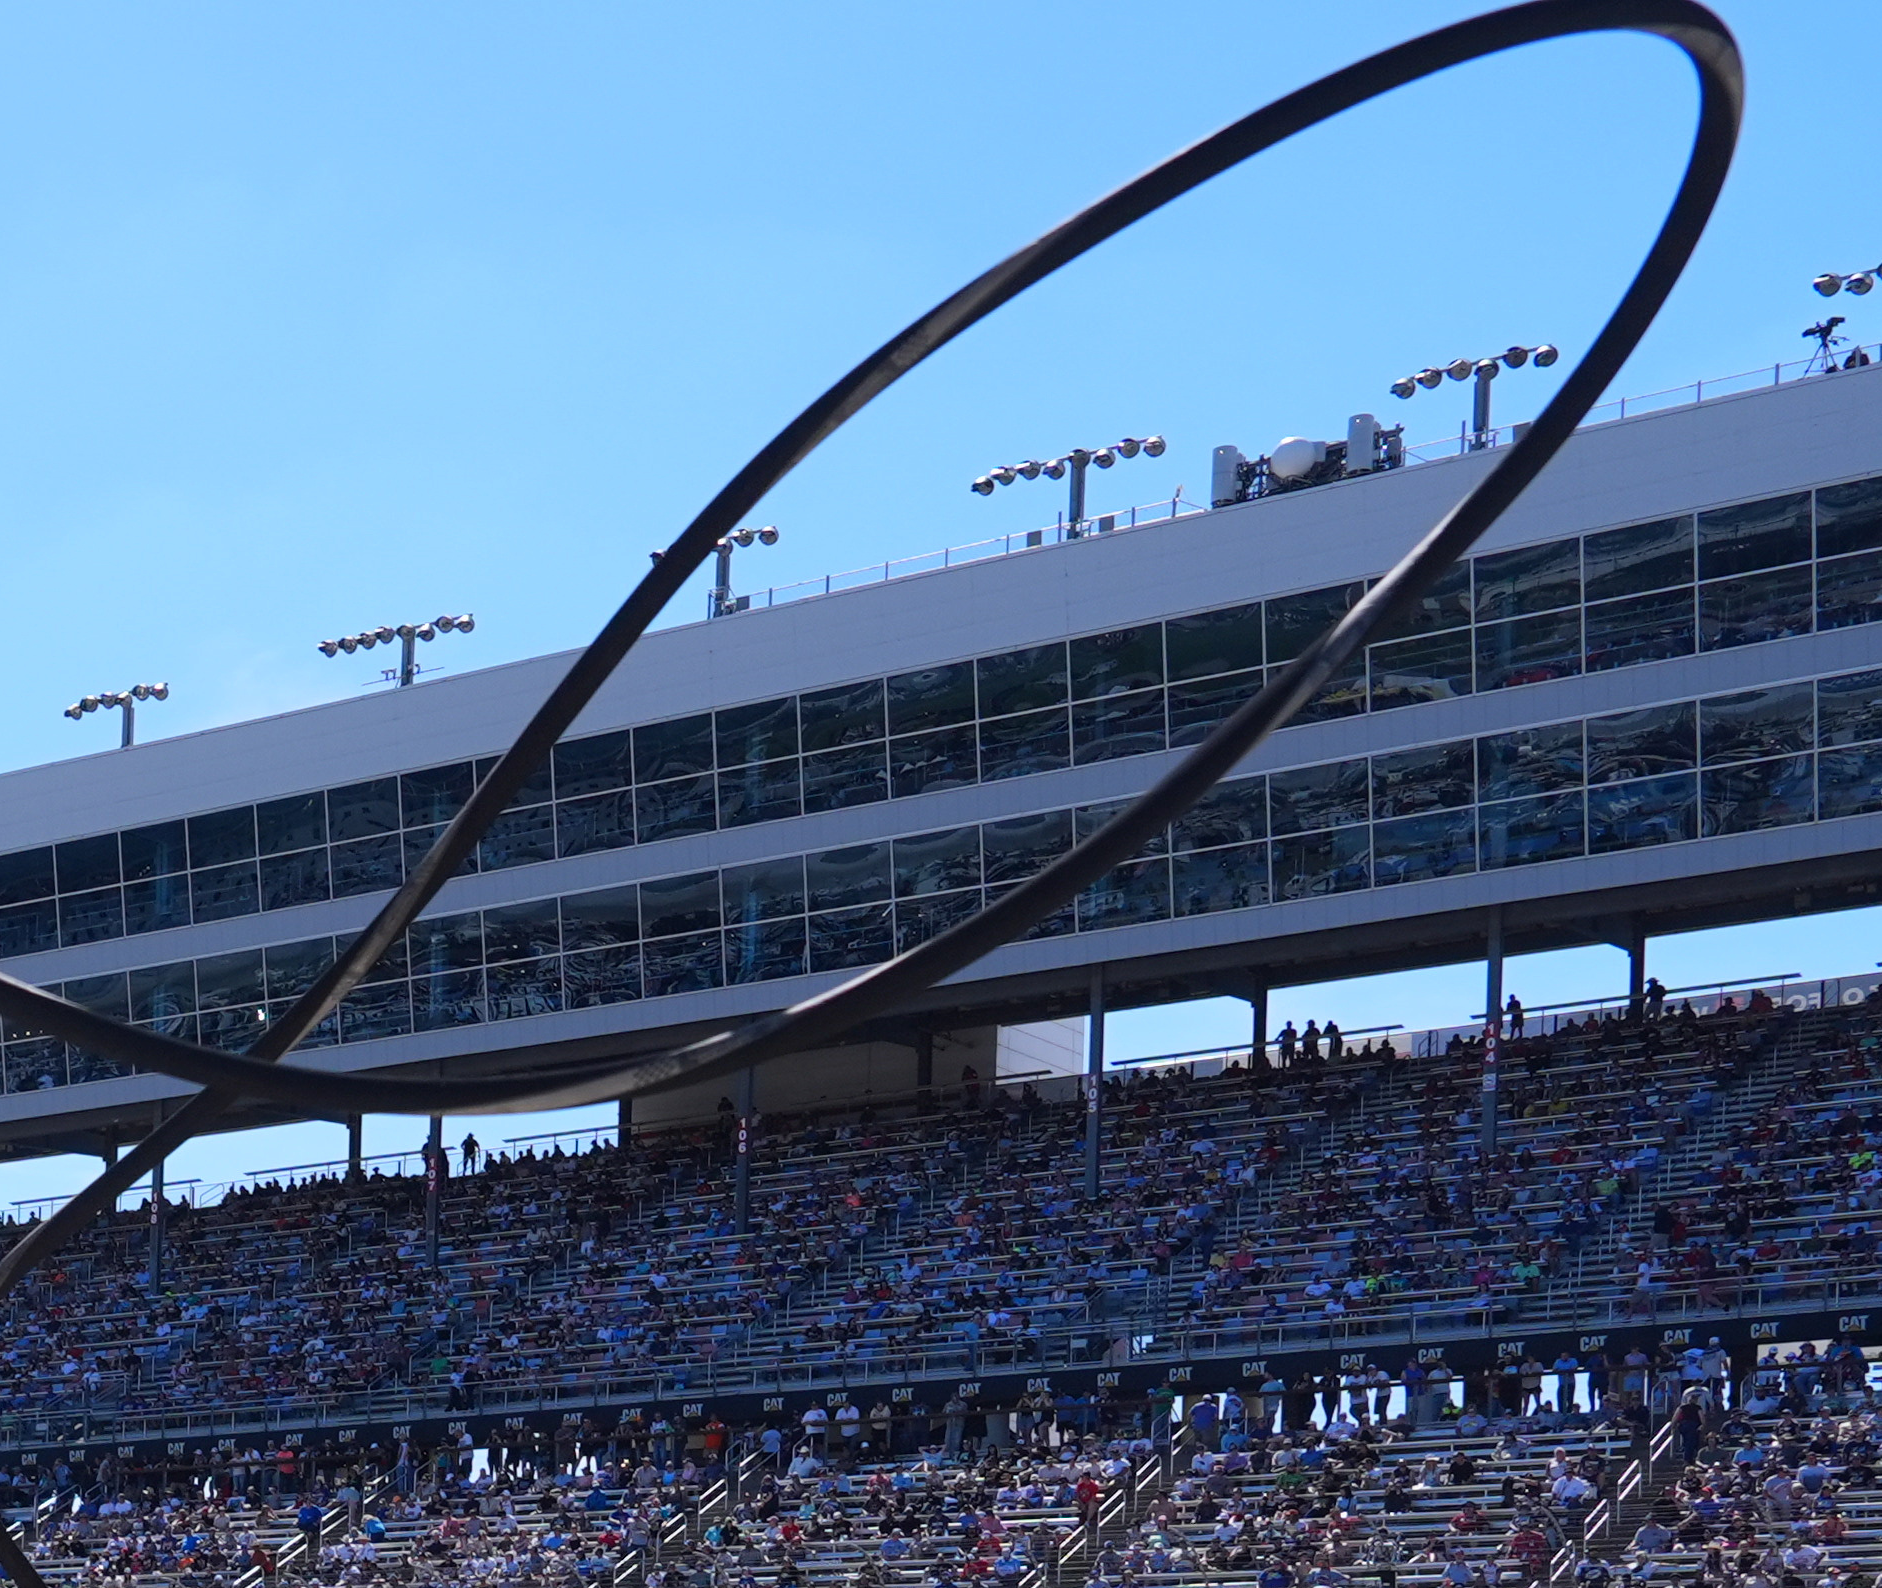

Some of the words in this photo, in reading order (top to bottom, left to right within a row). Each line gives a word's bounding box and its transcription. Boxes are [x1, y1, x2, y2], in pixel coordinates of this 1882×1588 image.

[1485, 1023, 1495, 1064] 104
[1087, 1074, 1097, 1114] 105
[737, 1117, 747, 1154] 106
[427, 1157, 436, 1191] 107
[1839, 1316, 1868, 1332] CAT
[1664, 1329, 1691, 1345] CAT
[1750, 1323, 1779, 1339] CAT
[1498, 1342, 1524, 1357] CAT
[1580, 1335, 1607, 1351] CAT
[1340, 1354, 1366, 1369] CAT
[1418, 1348, 1443, 1364] CAT
[1169, 1367, 1192, 1381] CAT
[1242, 1362, 1266, 1376] CAT
[1027, 1378, 1049, 1392] CAT
[1098, 1372, 1118, 1386] CAT
[892, 1388, 913, 1401] CAT
[959, 1383, 980, 1396] CAT
[763, 1398, 783, 1410] CAT
[827, 1393, 848, 1406] CAT
[623, 1408, 642, 1420] CAT
[683, 1404, 702, 1416] CAT
[505, 1418, 523, 1430] CAT
[563, 1413, 582, 1425] CAT
[393, 1426, 411, 1438] CAT
[449, 1422, 466, 1434] CAT
[286, 1434, 303, 1446] CAT
[339, 1430, 356, 1442] CAT
[168, 1442, 184, 1455] CAT
[218, 1439, 235, 1450] CAT
[69, 1450, 85, 1462] CAT
[118, 1446, 134, 1458] CAT
[22, 1454, 37, 1465] CAT
